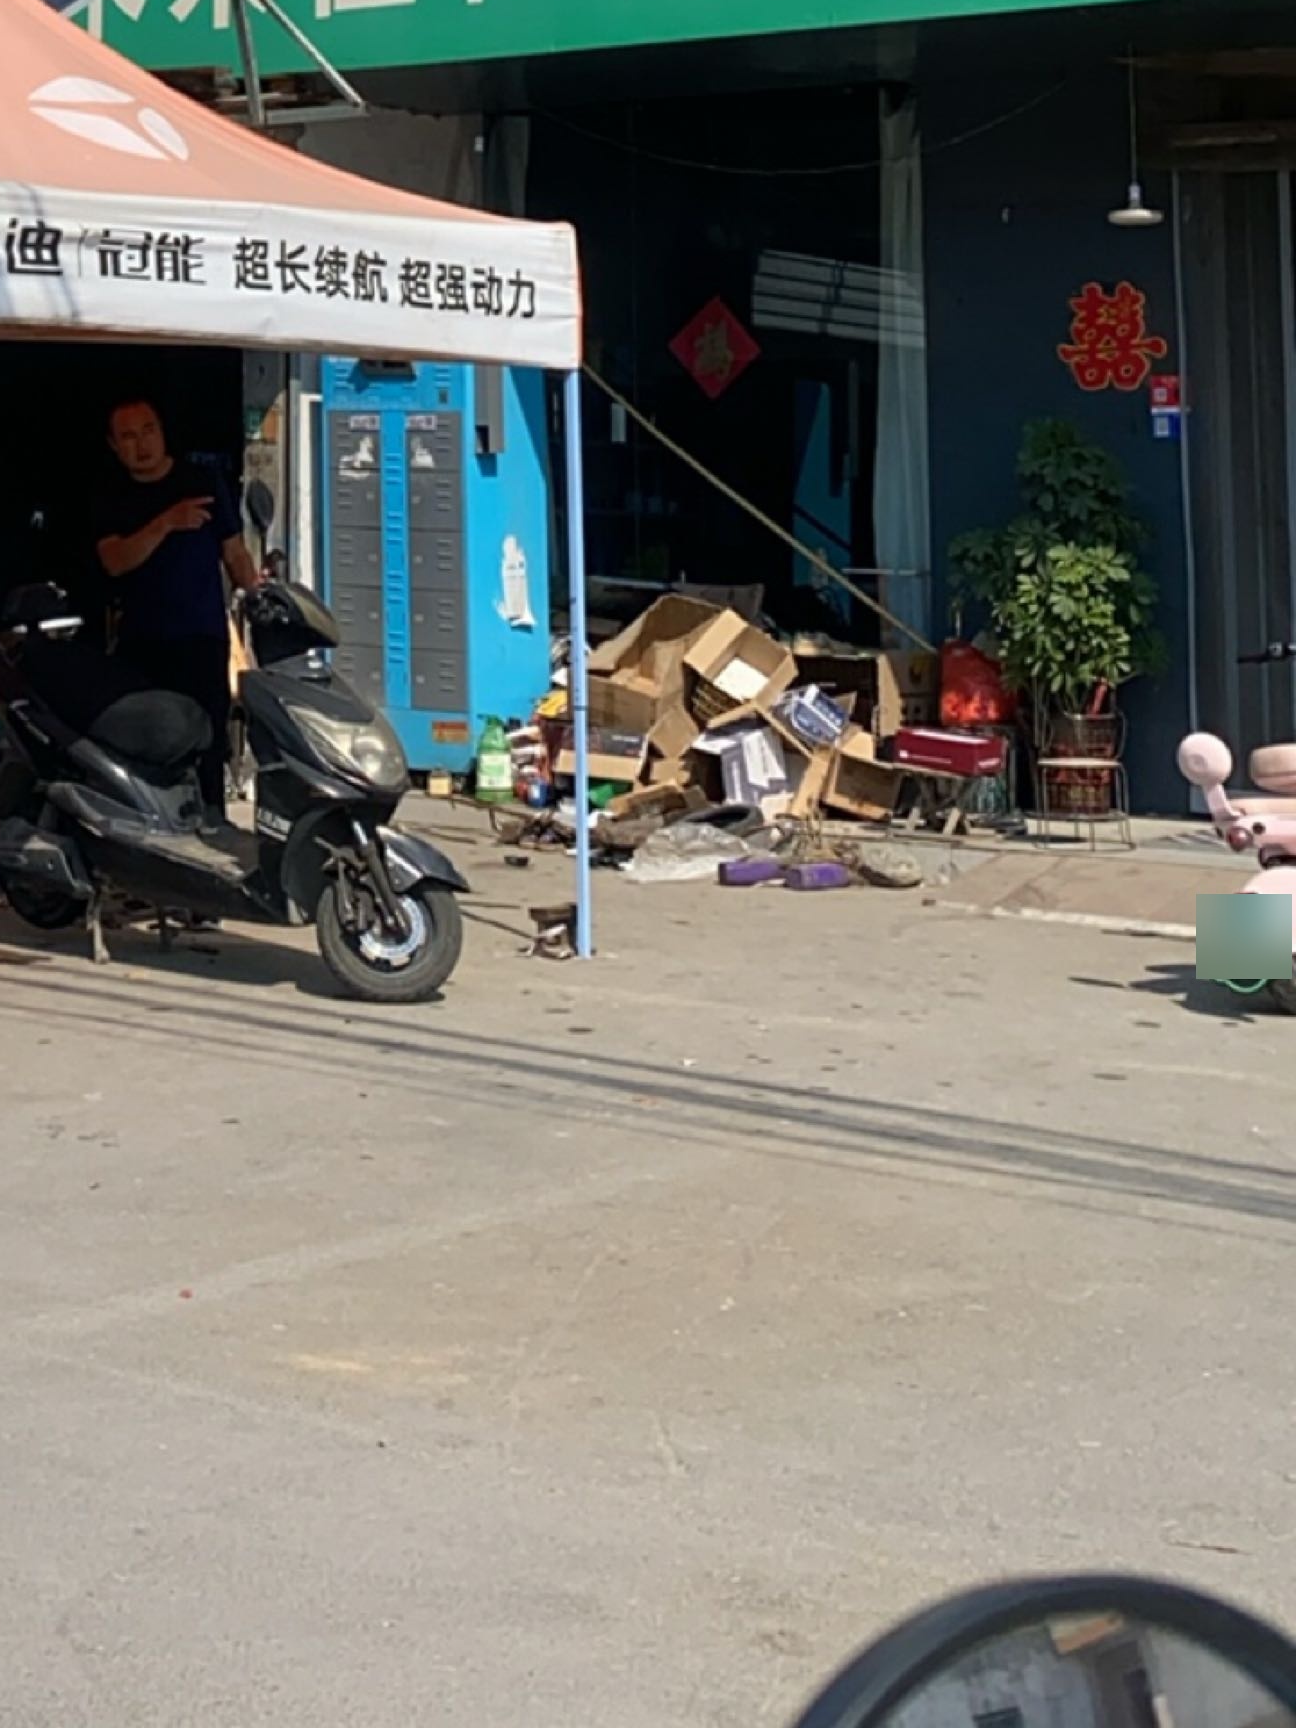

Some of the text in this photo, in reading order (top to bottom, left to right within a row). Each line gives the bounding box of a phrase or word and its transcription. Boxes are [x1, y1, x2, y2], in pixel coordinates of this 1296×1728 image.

[99, 229, 207, 284] 冠能
[234, 236, 388, 304] 超长续航
[399, 261, 538, 320] 超强动力
